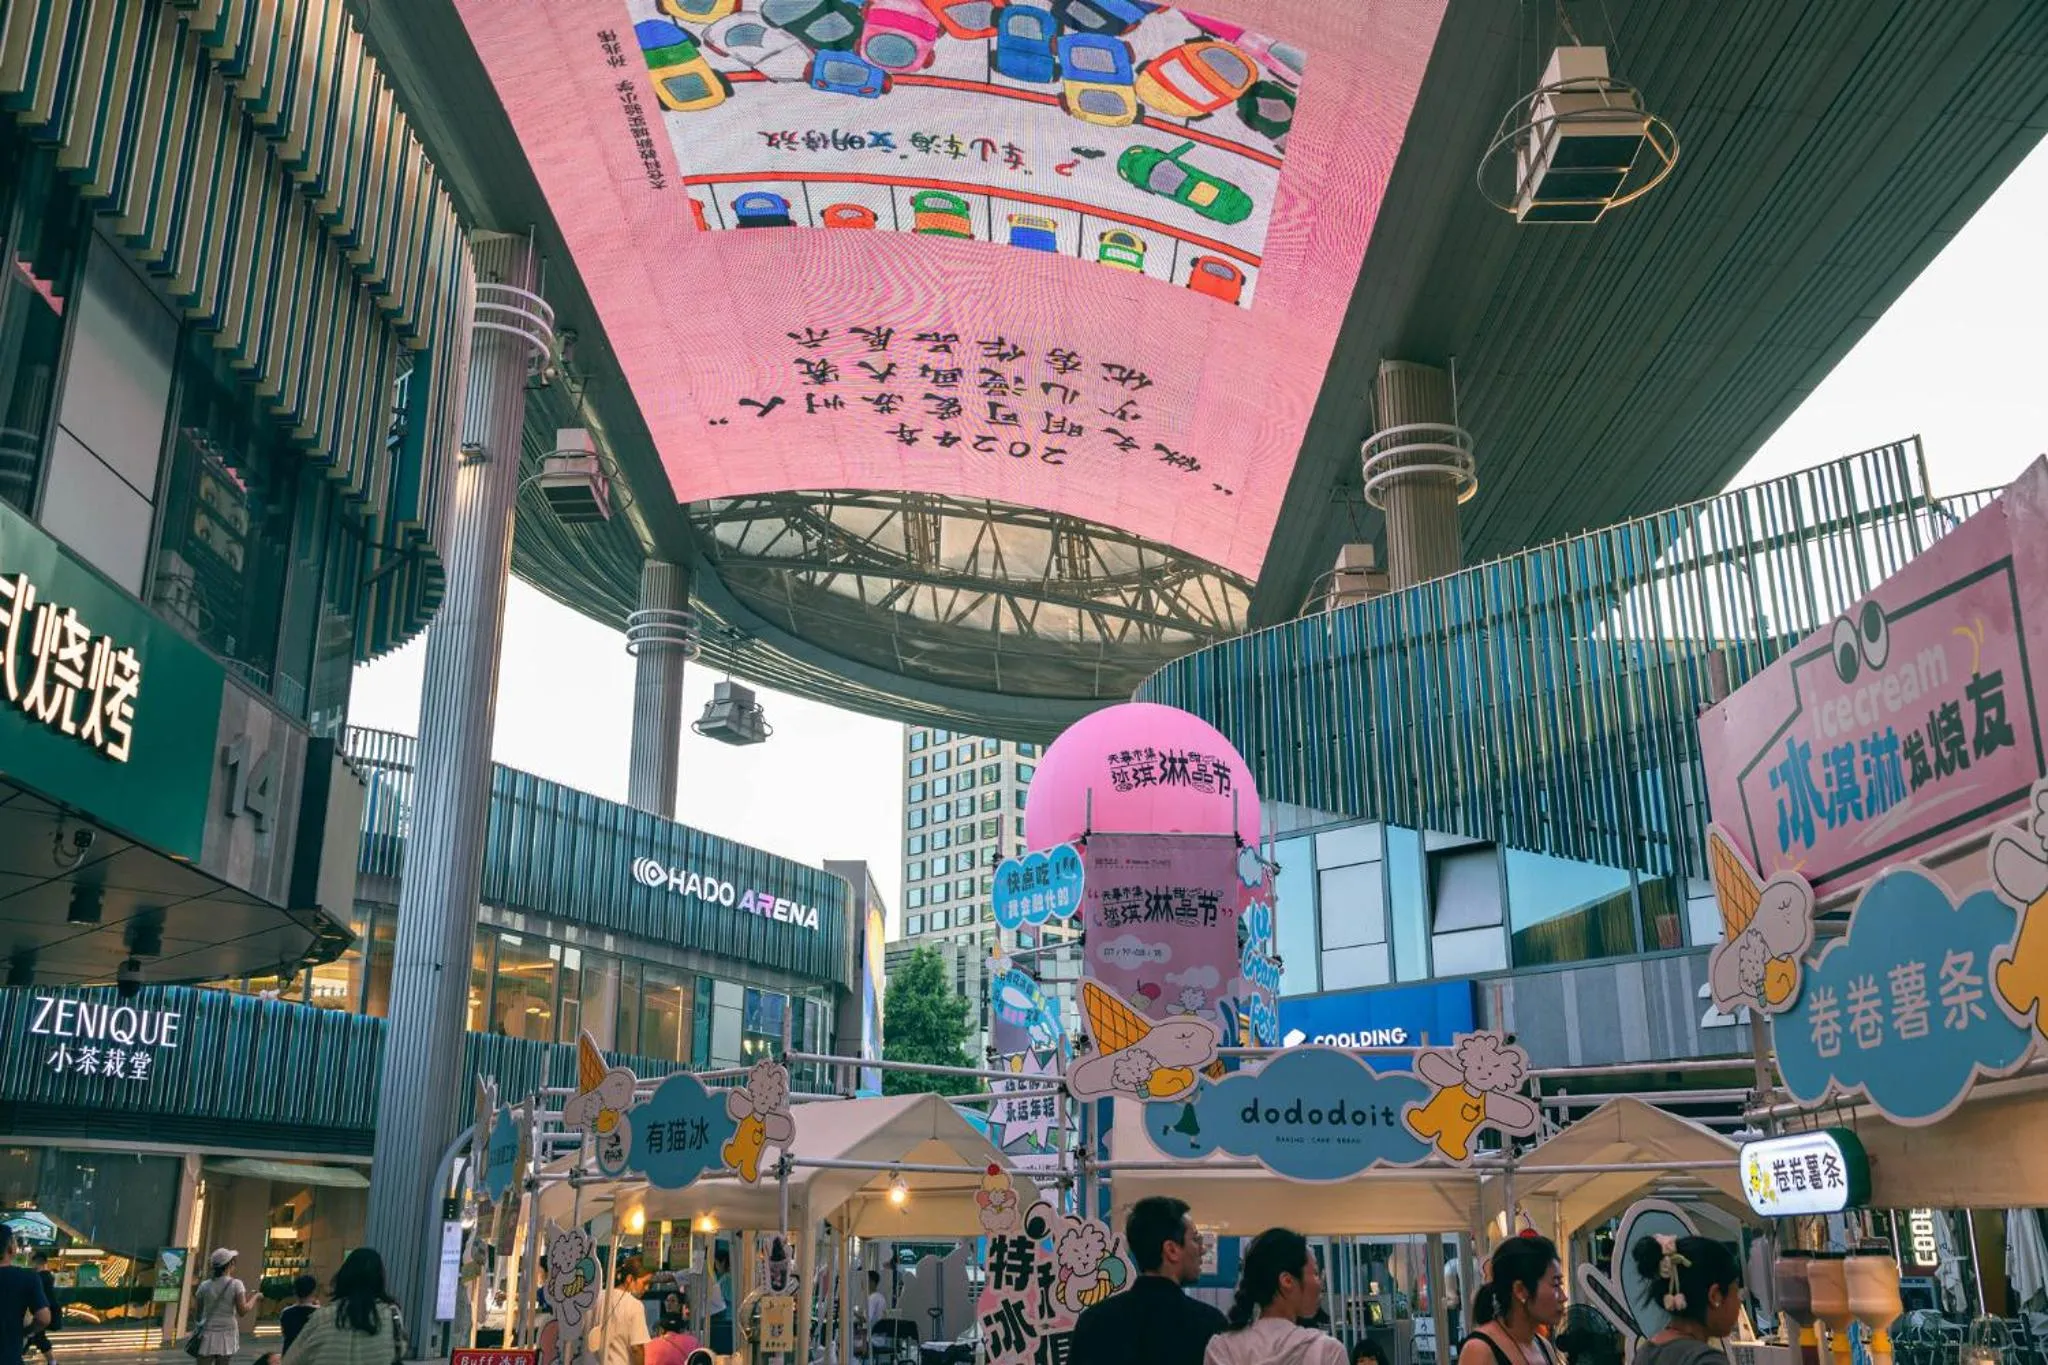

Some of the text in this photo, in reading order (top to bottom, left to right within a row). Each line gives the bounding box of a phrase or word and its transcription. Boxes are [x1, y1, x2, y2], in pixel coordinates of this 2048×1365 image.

[786, 327, 1152, 393] 优秀作品展示
[794, 357, 1142, 423] 少儿漫画大赛
[885, 422, 1068, 467] 2024年
[1809, 642, 1949, 741] icecream
[221, 735, 277, 832] 14
[1768, 668, 2015, 854] 冰淇淋发烧友
[668, 867, 820, 931] HADO ARENA
[31, 997, 181, 1048] ZENIQUE
[1808, 949, 1987, 1059] 卷卷薯条
[46, 1043, 153, 1081] 小茶栽堂
[646, 1116, 709, 1155] 有猫冰
[1241, 1098, 1395, 1127] dododoit
[1772, 1152, 1845, 1193] 卷卷薯条
